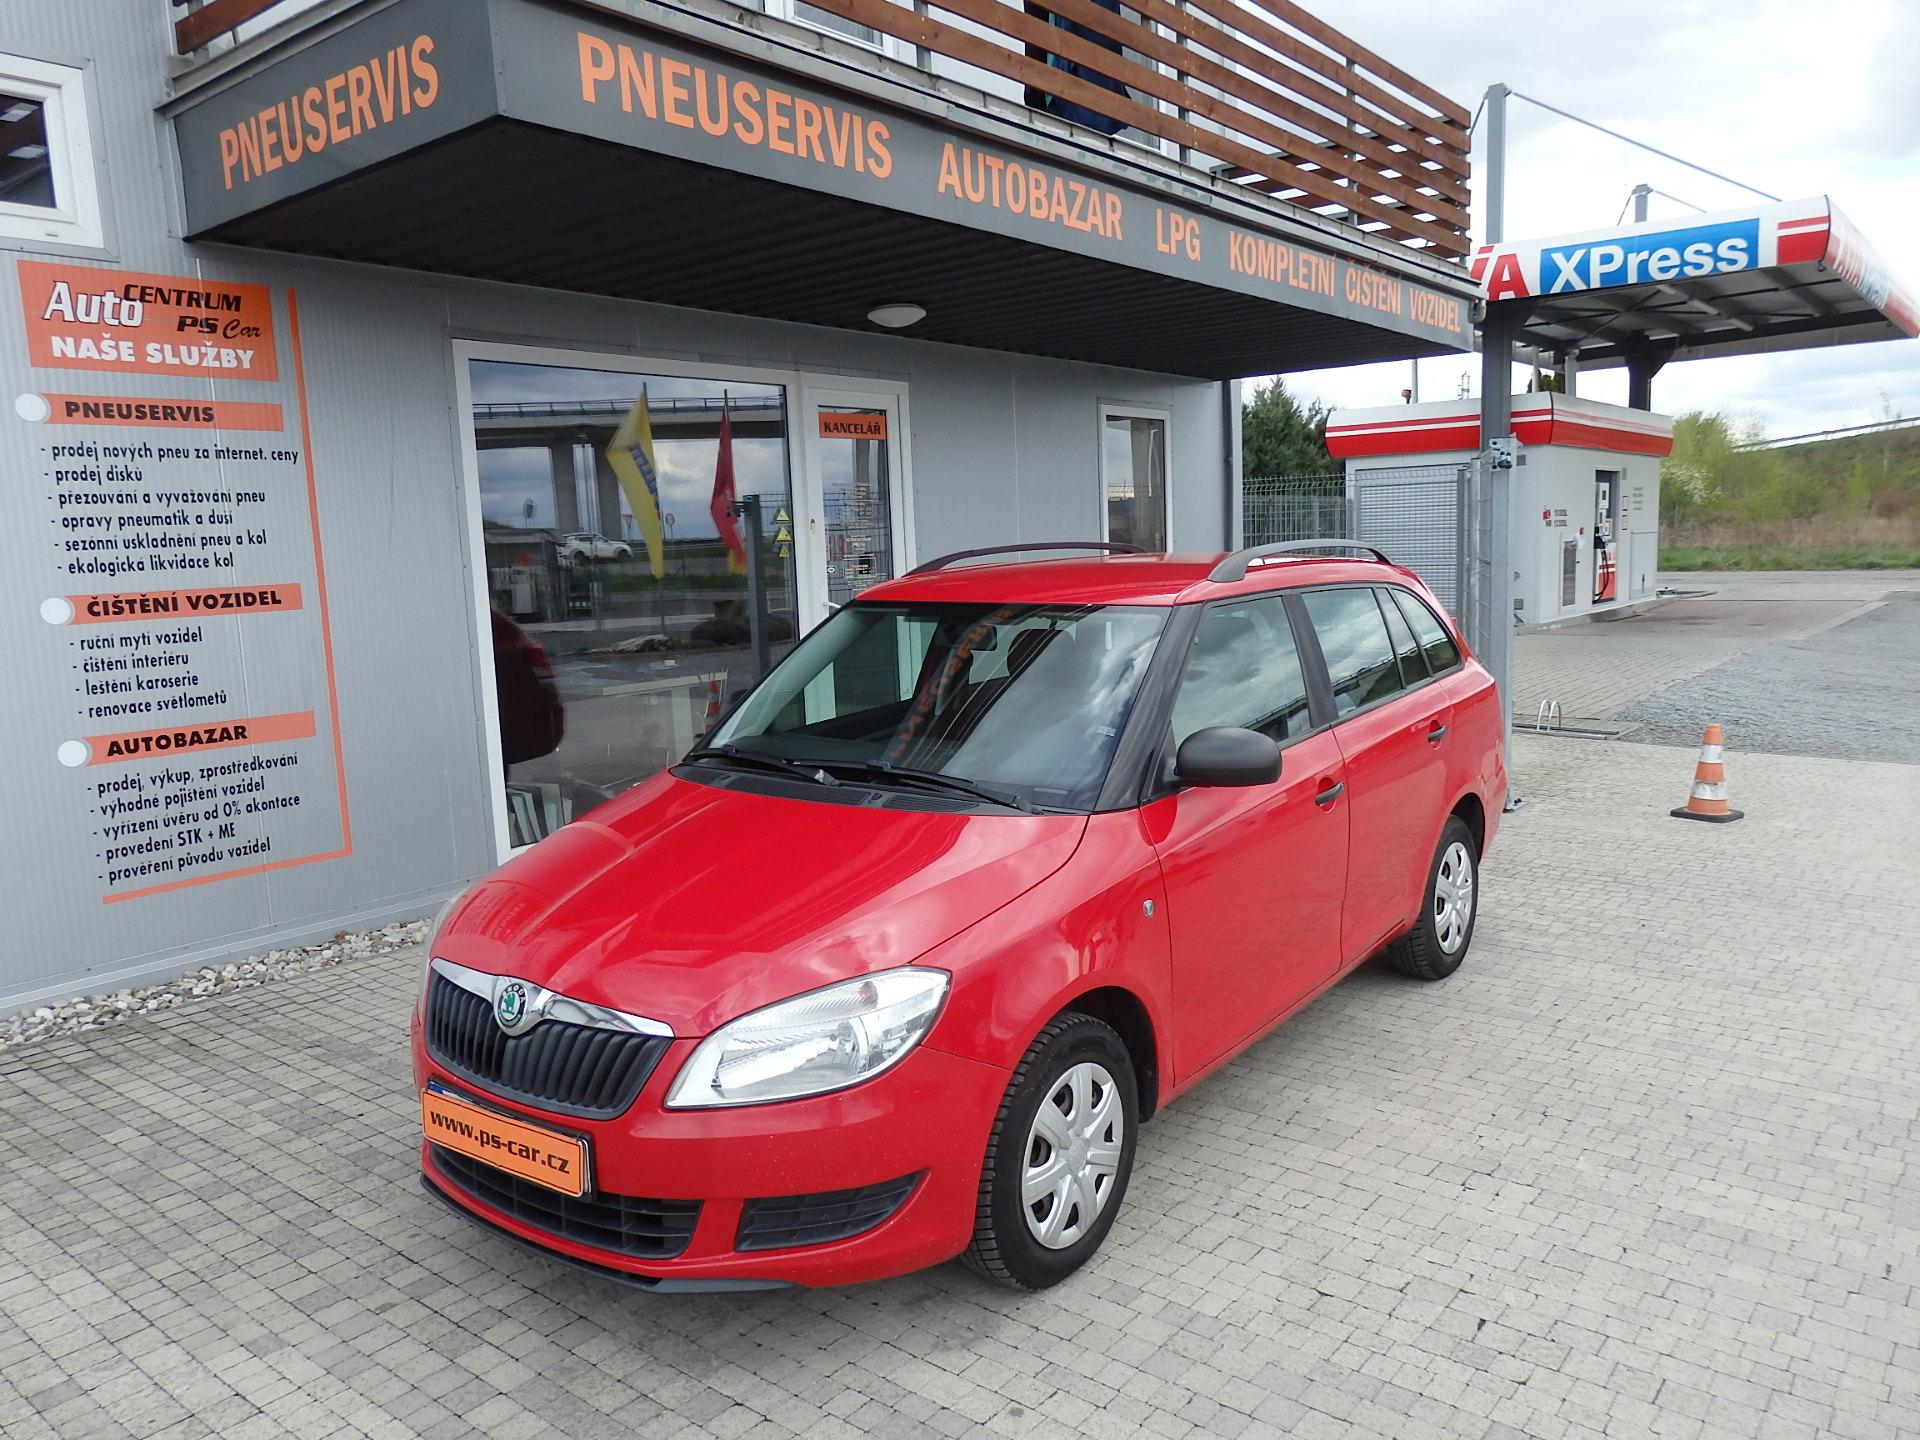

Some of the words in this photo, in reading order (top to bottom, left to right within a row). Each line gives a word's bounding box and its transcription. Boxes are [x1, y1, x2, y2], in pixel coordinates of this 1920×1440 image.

[217, 34, 440, 192] PNEUSERVIS
[576, 31, 894, 180] PNEUSERVIS
[936, 141, 1124, 241] AUTOBAZAR
[1155, 208, 1202, 262] LPG
[1228, 230, 1337, 297] KOMPLETNÍ
[1345, 257, 1404, 315] ČIŠTĚNÍ
[1409, 287, 1462, 333] VOZIDEL
[1550, 236, 1750, 294] XPress
[41, 280, 144, 327] Auto
[123, 284, 242, 312] CENTRUM
[176, 315, 219, 334] PS
[222, 319, 262, 340] Car
[50, 332, 136, 363] NAŠE
[146, 340, 255, 369] SLUŽBY
[64, 401, 215, 423] PNEUSERVIS
[823, 421, 881, 435] KANCELÁŘ
[52, 441, 98, 463] prodej
[103, 442, 152, 462] nových
[158, 447, 190, 462] pneu
[195, 448, 209, 459] za
[215, 444, 267, 461] internet.
[271, 450, 299, 464] ceny
[56, 465, 101, 485] prodej
[59, 490, 137, 508] přezouvání
[143, 493, 151, 505] a
[157, 489, 231, 507] vyvažování
[236, 491, 266, 506] pneu
[62, 515, 112, 531] opravy
[119, 510, 190, 530] pneumatik
[195, 513, 203, 525] a
[208, 509, 233, 525] duší
[65, 536, 118, 551] sezónní
[123, 532, 196, 550] uskladnění
[201, 534, 231, 550] pneu
[236, 535, 243, 546] a
[247, 529, 267, 545] kol
[68, 557, 145, 577] ekologická
[149, 554, 209, 572] likvidace
[214, 552, 234, 568] kol
[87, 592, 179, 617] ČIŠTĚNÍ
[186, 590, 282, 611] VOZIDEL
[80, 633, 115, 650] ruční
[120, 630, 151, 651] mytí
[156, 626, 203, 645] vozidel
[83, 655, 128, 673] čištění
[132, 651, 189, 669] interiéru
[85, 678, 132, 696] leštění
[136, 671, 199, 690] karoserie
[88, 699, 152, 718] renovace
[157, 689, 227, 712] světlometů
[107, 725, 248, 757] AUTOBAZAR
[97, 773, 145, 798] prodej,
[149, 768, 194, 790] výkup,
[199, 752, 298, 782] zprostředkování
[100, 794, 159, 819] výhodné
[165, 785, 217, 810] pojištění
[222, 776, 265, 796] vozidel
[103, 818, 159, 841] vyřízení
[163, 811, 199, 829] úvěru
[204, 805, 219, 821] od
[223, 802, 241, 817] 0%
[245, 794, 301, 813] akontace
[106, 837, 174, 864] provedení
[178, 828, 203, 847] STK
[219, 823, 236, 840] ME
[108, 858, 174, 885] prověření
[178, 848, 224, 871] původu
[228, 837, 271, 858] vozidel
[430, 1110, 571, 1175] www.ps-car.cz
